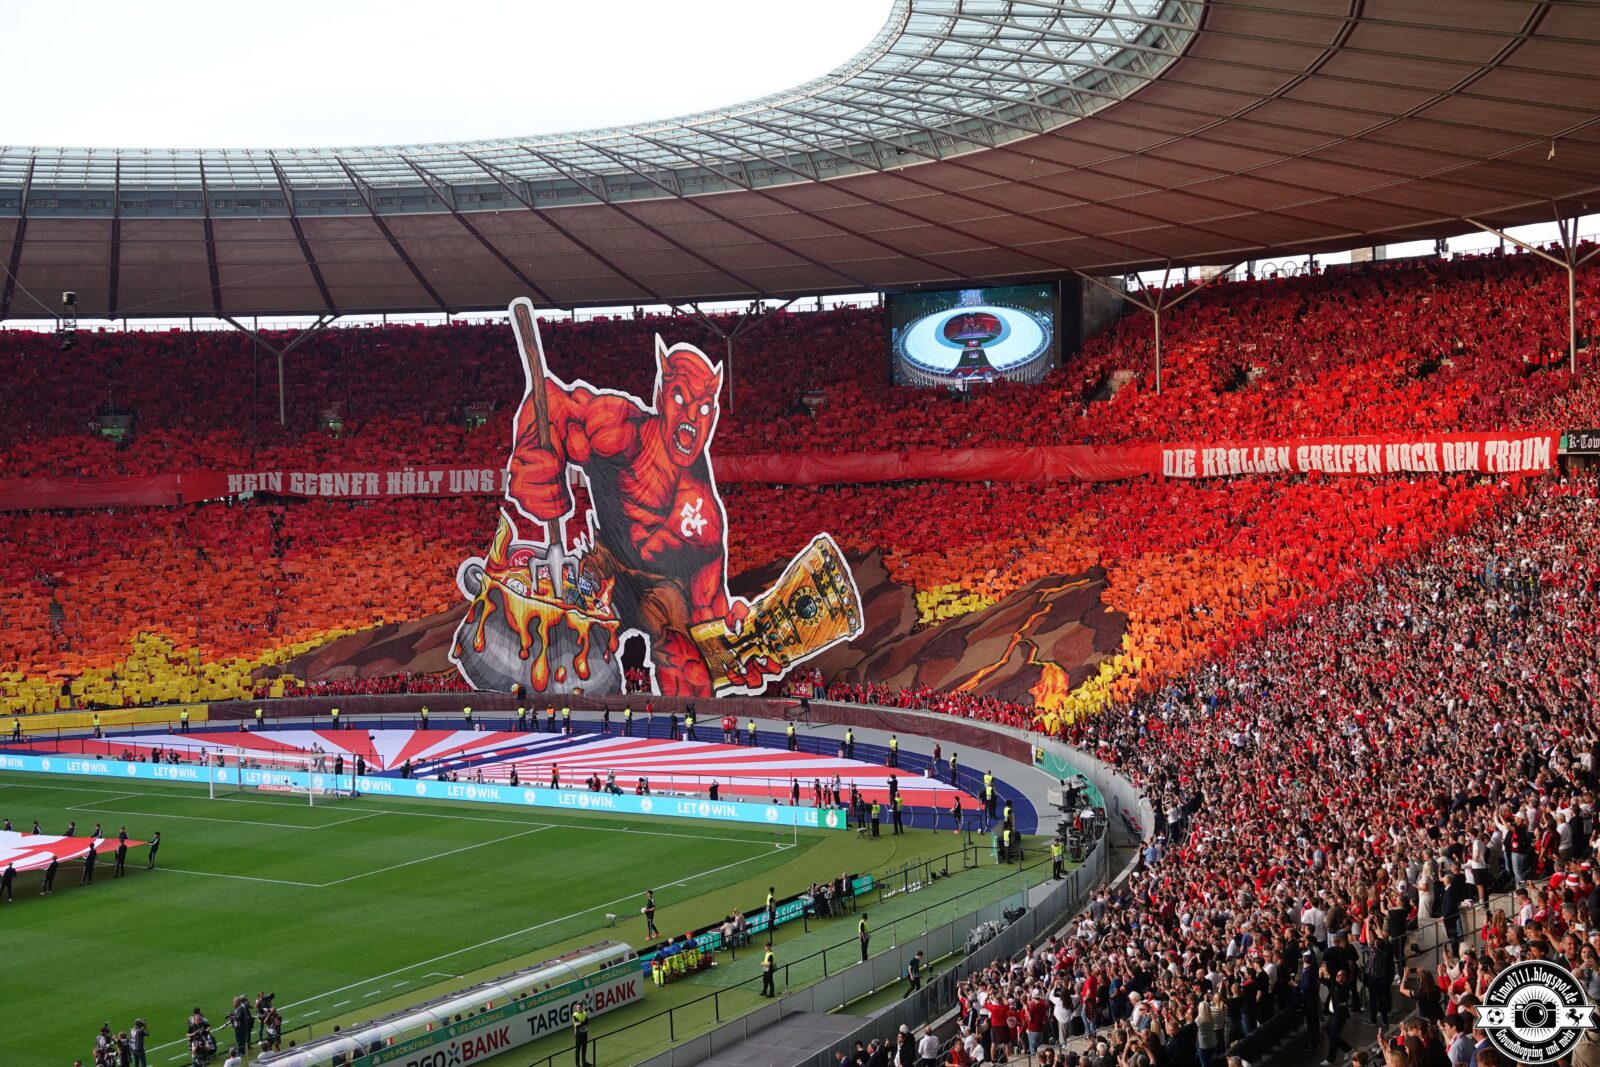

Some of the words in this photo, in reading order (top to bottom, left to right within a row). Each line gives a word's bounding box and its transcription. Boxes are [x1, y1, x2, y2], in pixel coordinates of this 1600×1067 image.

[1163, 449, 1197, 477] DIE
[1202, 446, 1293, 477] KRALLEN
[1297, 444, 1382, 474] GREIFEN
[1385, 442, 1439, 473] NACH
[1442, 441, 1479, 472] DEM
[1485, 436, 1551, 473] TRAUM
[289, 472, 380, 496] GEGNER
[386, 467, 444, 495] HÄLT
[449, 469, 495, 493] UNS
[67, 761, 81, 772] LET
[90, 762, 110, 774] WIN.
[154, 766, 169, 777] LET
[179, 769, 199, 779] WIN.
[246, 772, 261, 783] LET
[371, 780, 394, 792] WIN.
[447, 786, 465, 797] LET
[476, 788, 501, 800] WIN.
[559, 793, 577, 805] LET
[589, 796, 616, 808] WIN.
[678, 802, 697, 814] LET
[711, 804, 739, 818] WIN.
[595, 979, 637, 1012] BANK
[382, 1036, 433, 1061] DFB-POKALFINALE
[462, 1026, 511, 1062] BANK
